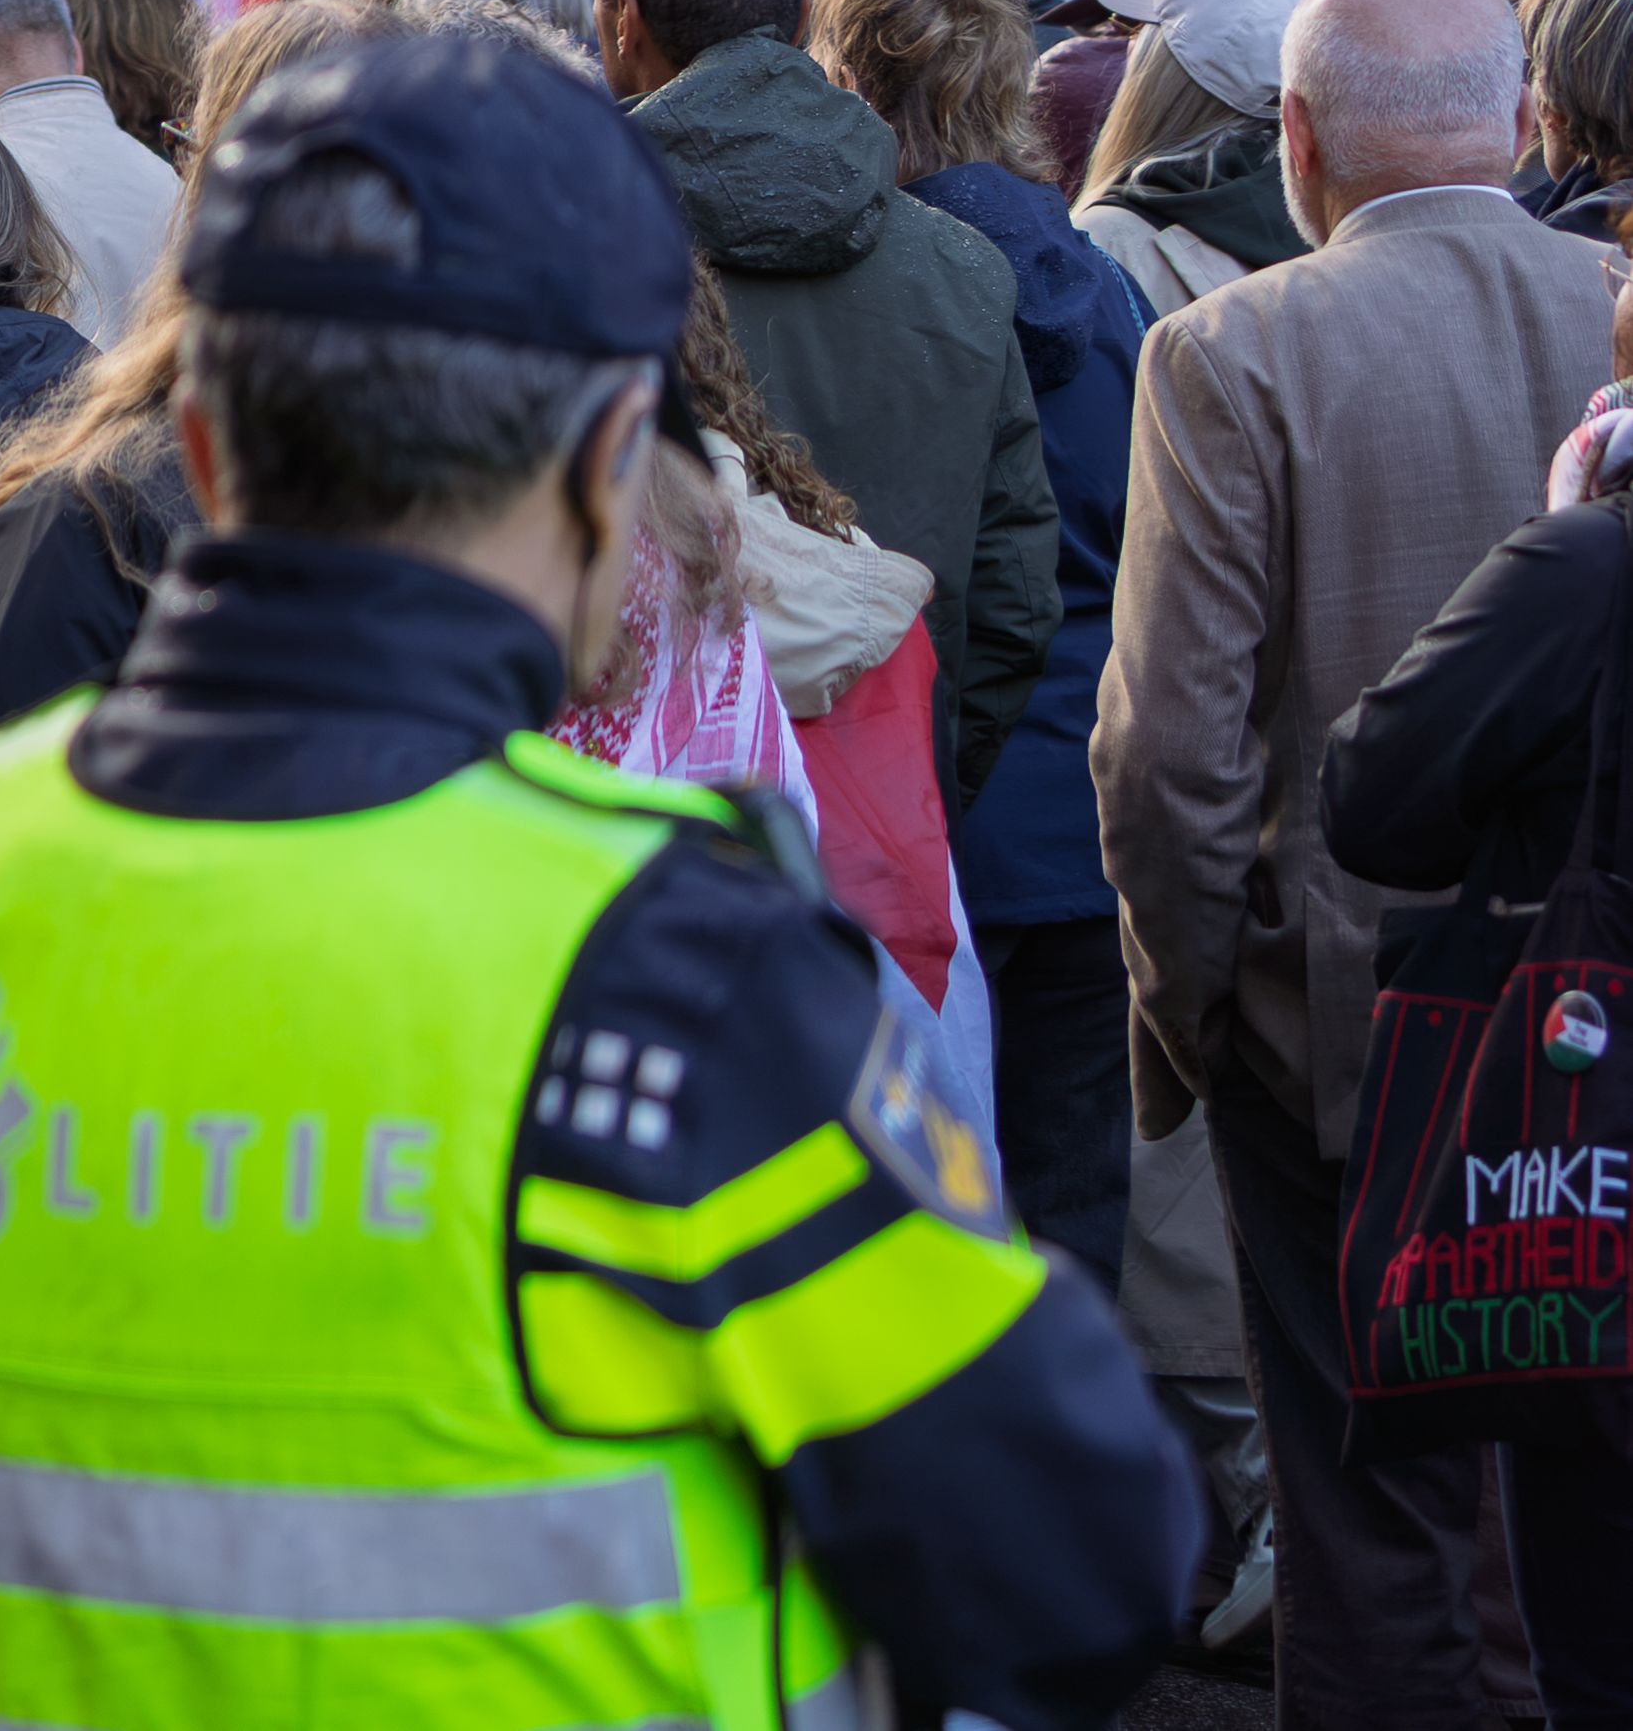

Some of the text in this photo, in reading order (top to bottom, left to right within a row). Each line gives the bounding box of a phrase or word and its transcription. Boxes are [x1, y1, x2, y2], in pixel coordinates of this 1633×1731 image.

[1465, 1144, 1629, 1226] MAKE
[1376, 1215, 1625, 1310] APARTHEID
[1398, 1291, 1624, 1382] HISTORY
